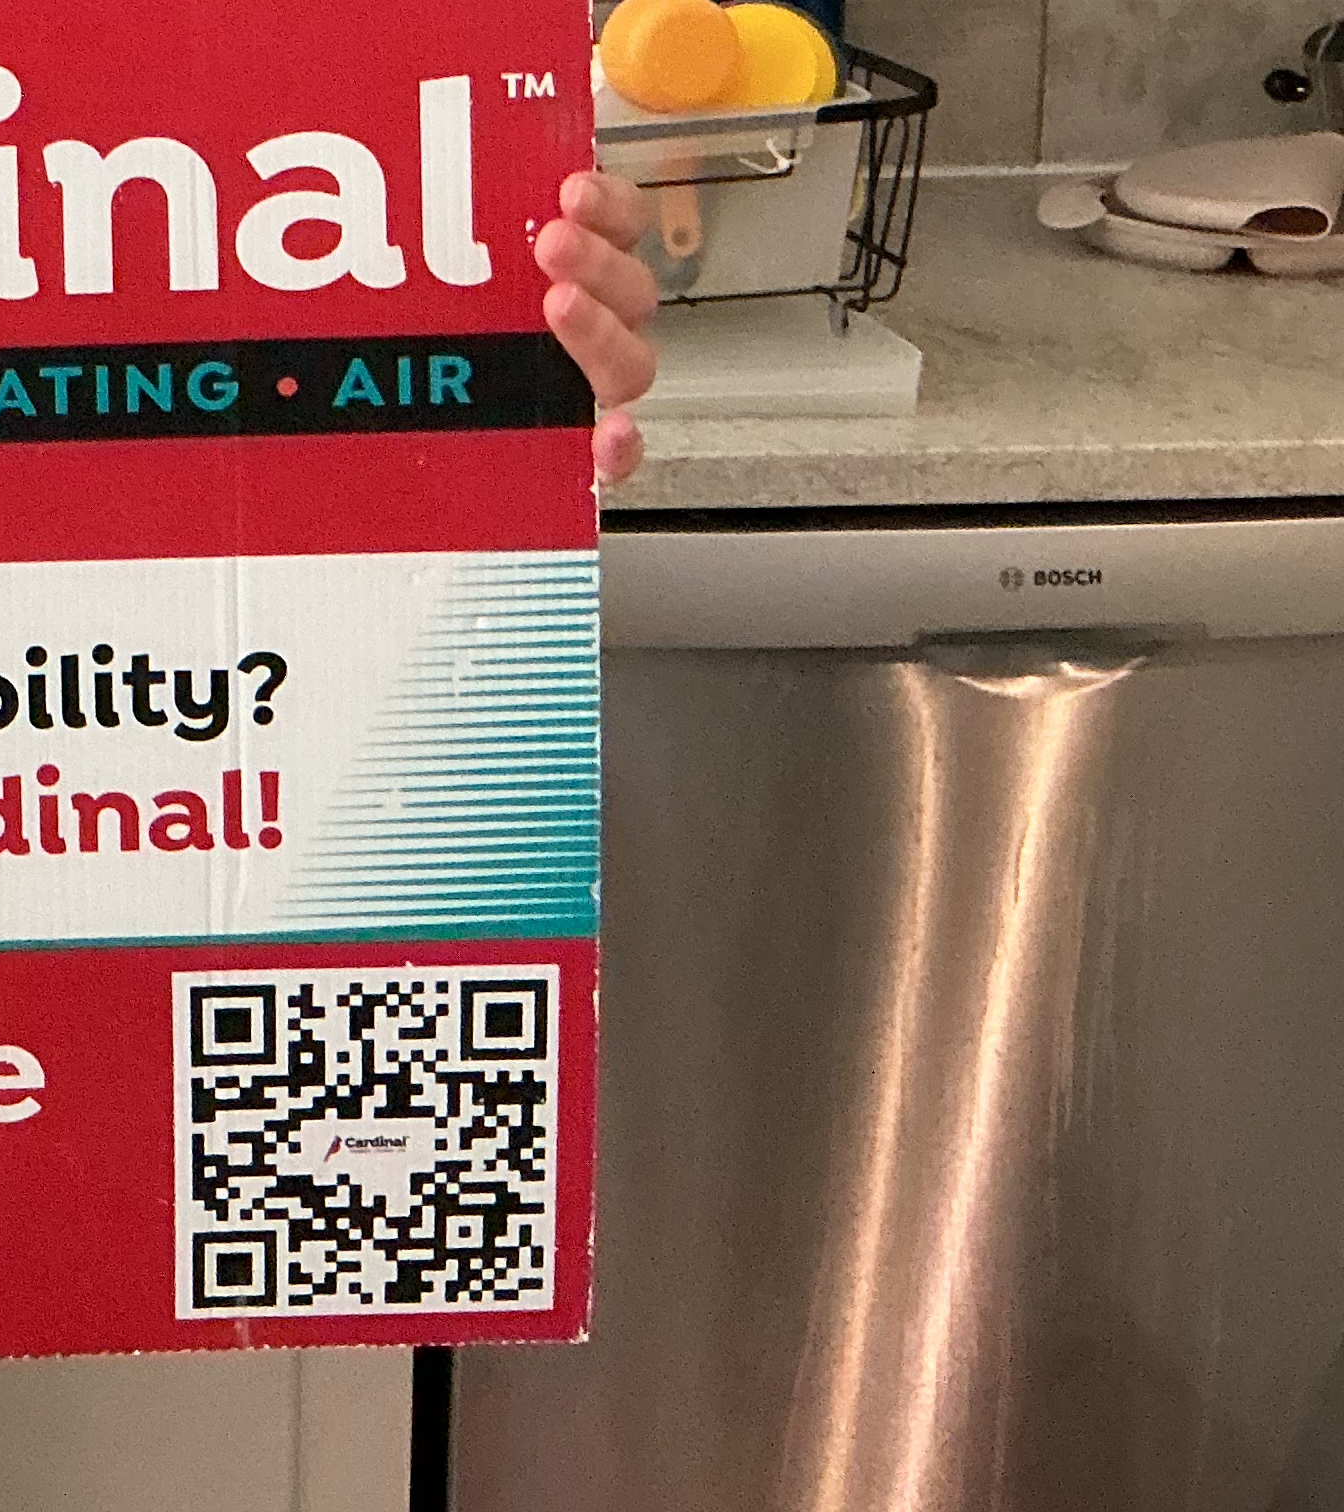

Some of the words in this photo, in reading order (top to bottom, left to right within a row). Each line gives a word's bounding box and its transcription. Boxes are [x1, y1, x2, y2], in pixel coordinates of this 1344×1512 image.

[333, 354, 473, 409] AIR
[1033, 569, 1103, 586] BOSCH
[344, 1135, 407, 1148] Cardinal
